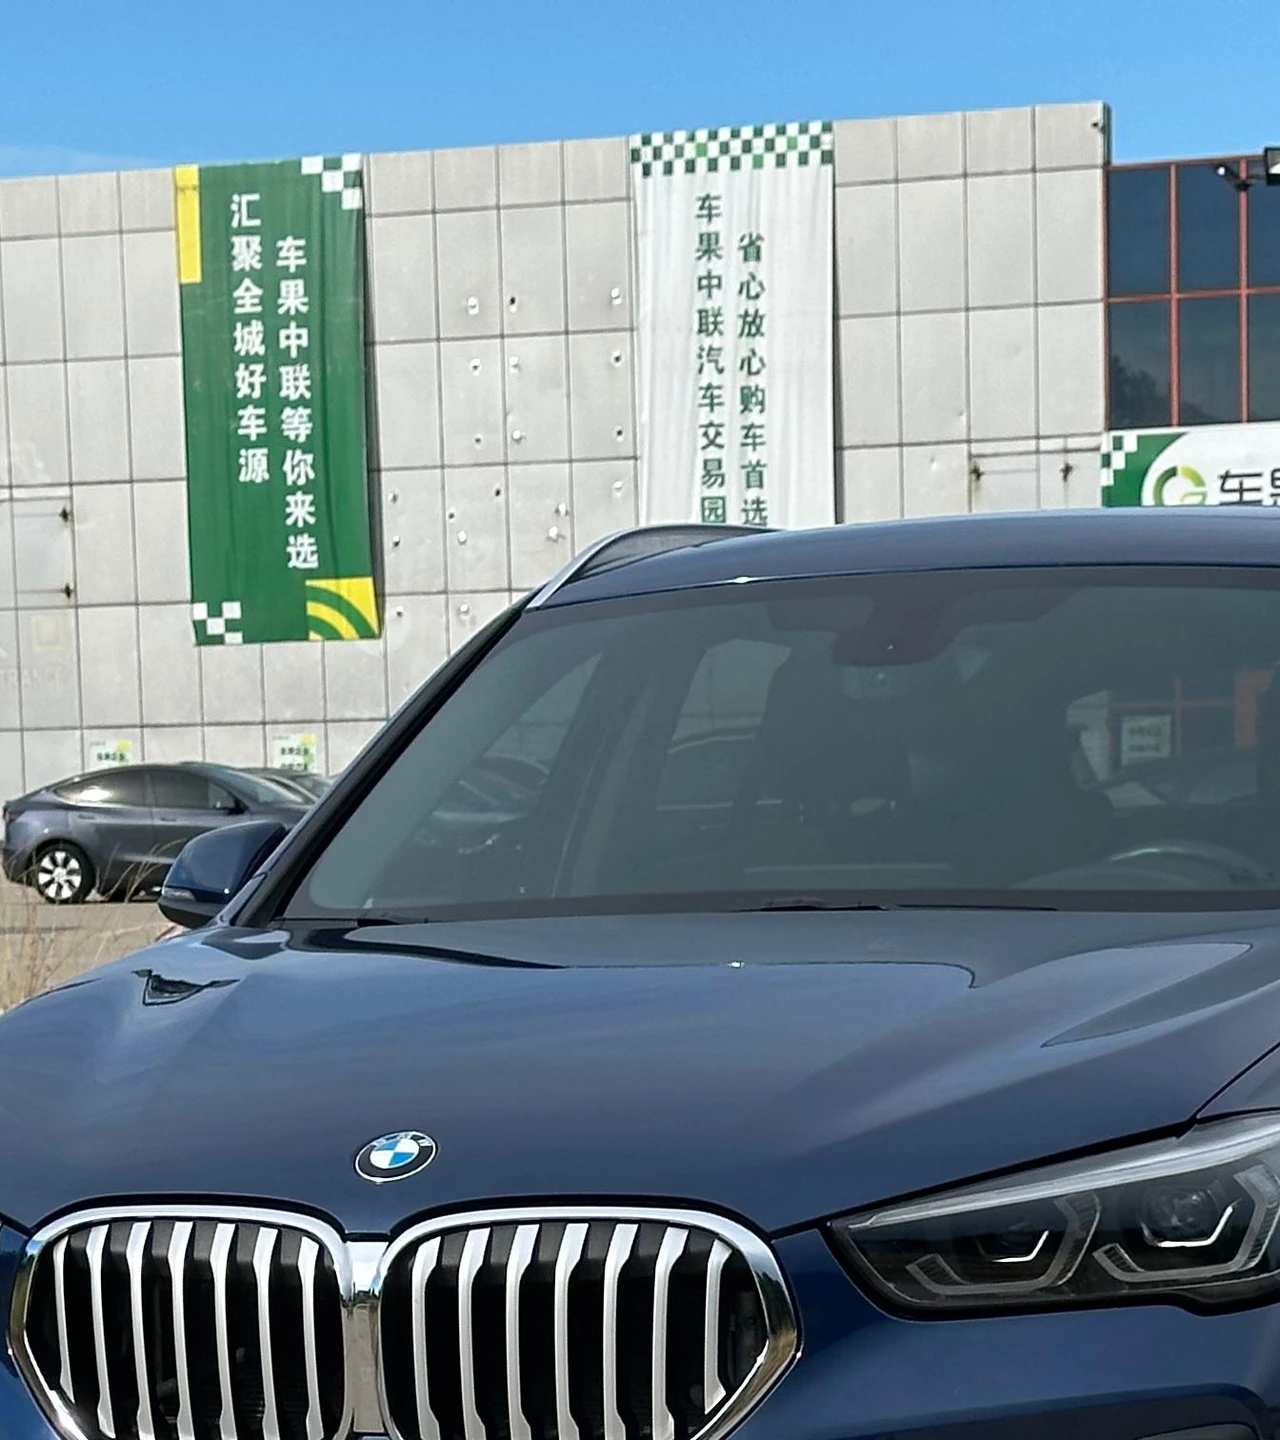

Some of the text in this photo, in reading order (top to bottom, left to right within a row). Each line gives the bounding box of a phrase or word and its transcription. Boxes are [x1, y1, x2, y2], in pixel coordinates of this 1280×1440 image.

[229, 191, 270, 484] 汇聚全城好车源
[274, 235, 320, 570] 车果中联等你来选
[694, 192, 727, 524] 车果中联汽车交易园
[738, 232, 767, 526] 省心放心购车首选
